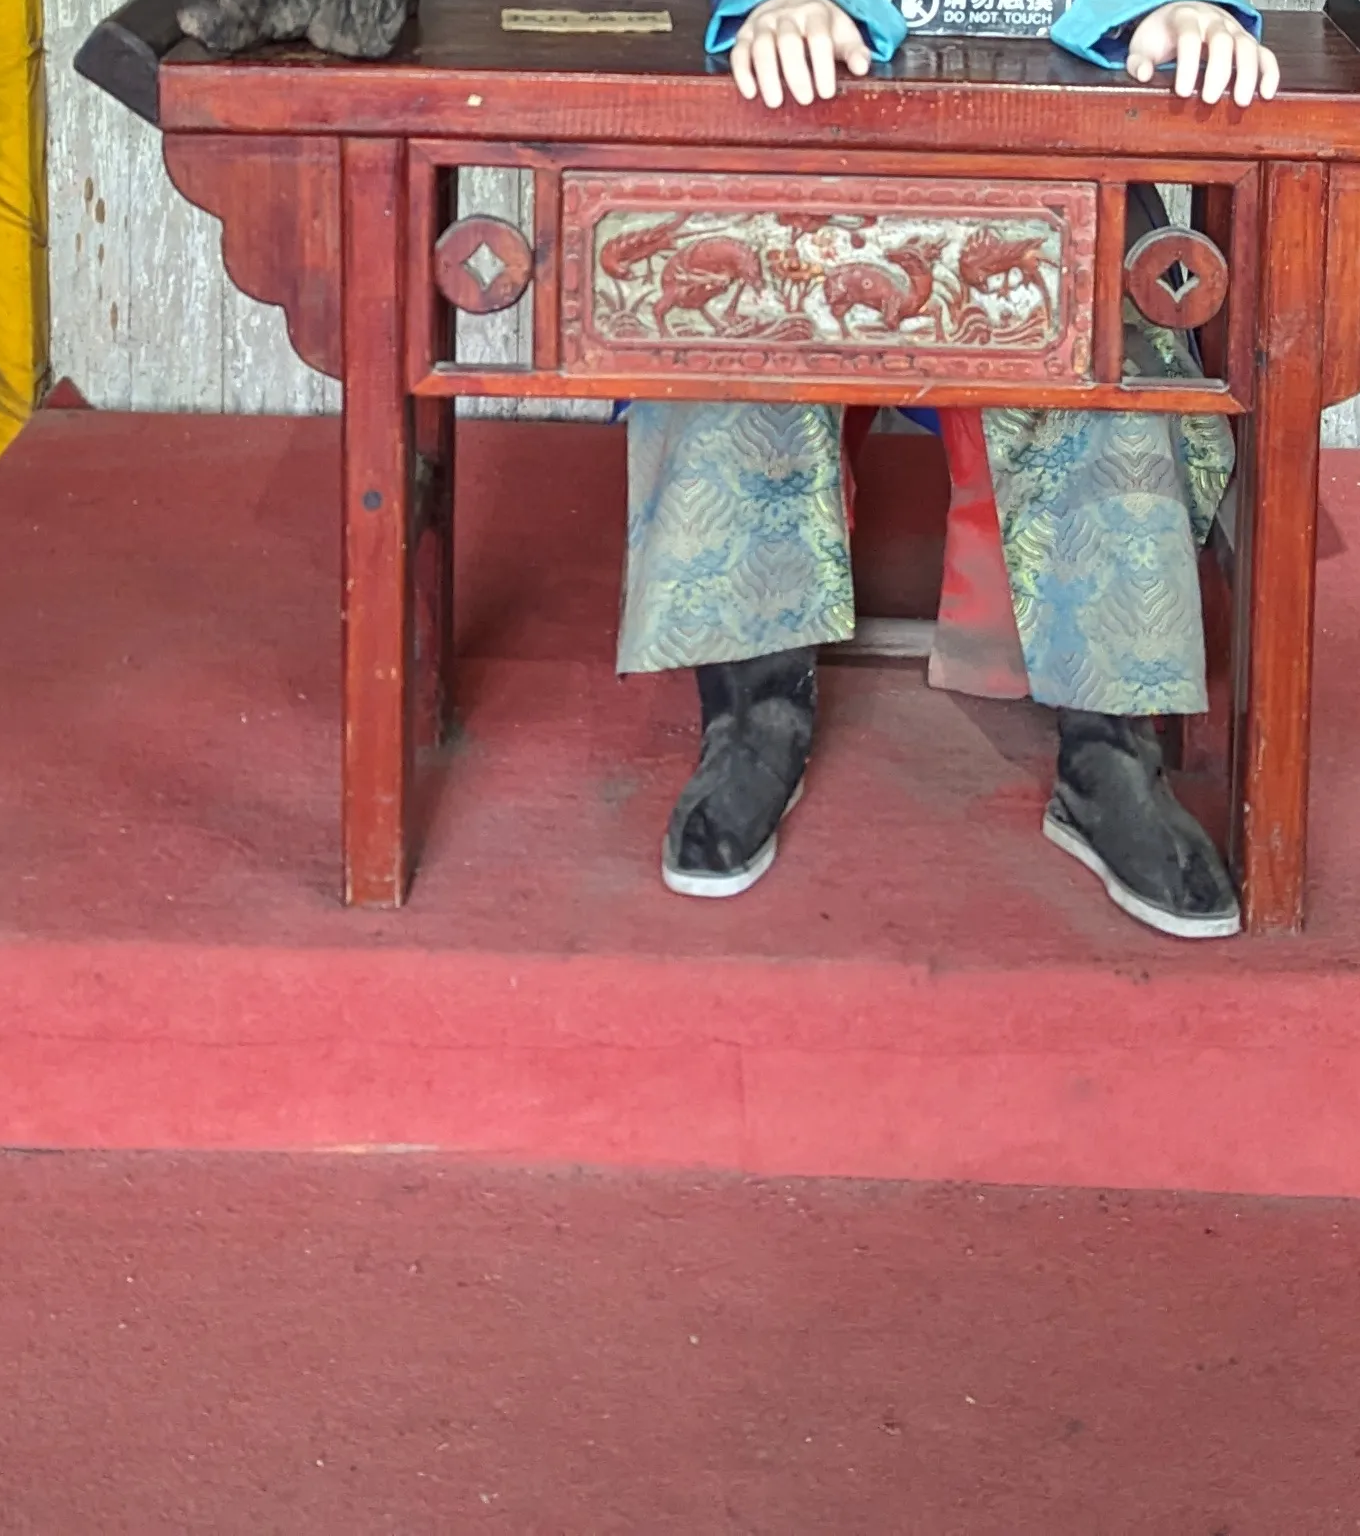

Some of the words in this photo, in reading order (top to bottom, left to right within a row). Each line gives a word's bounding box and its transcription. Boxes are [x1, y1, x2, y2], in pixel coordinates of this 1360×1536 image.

[943, 10, 966, 23] DO
[969, 10, 999, 24] NOT
[1003, 11, 1052, 25] TOUCH
